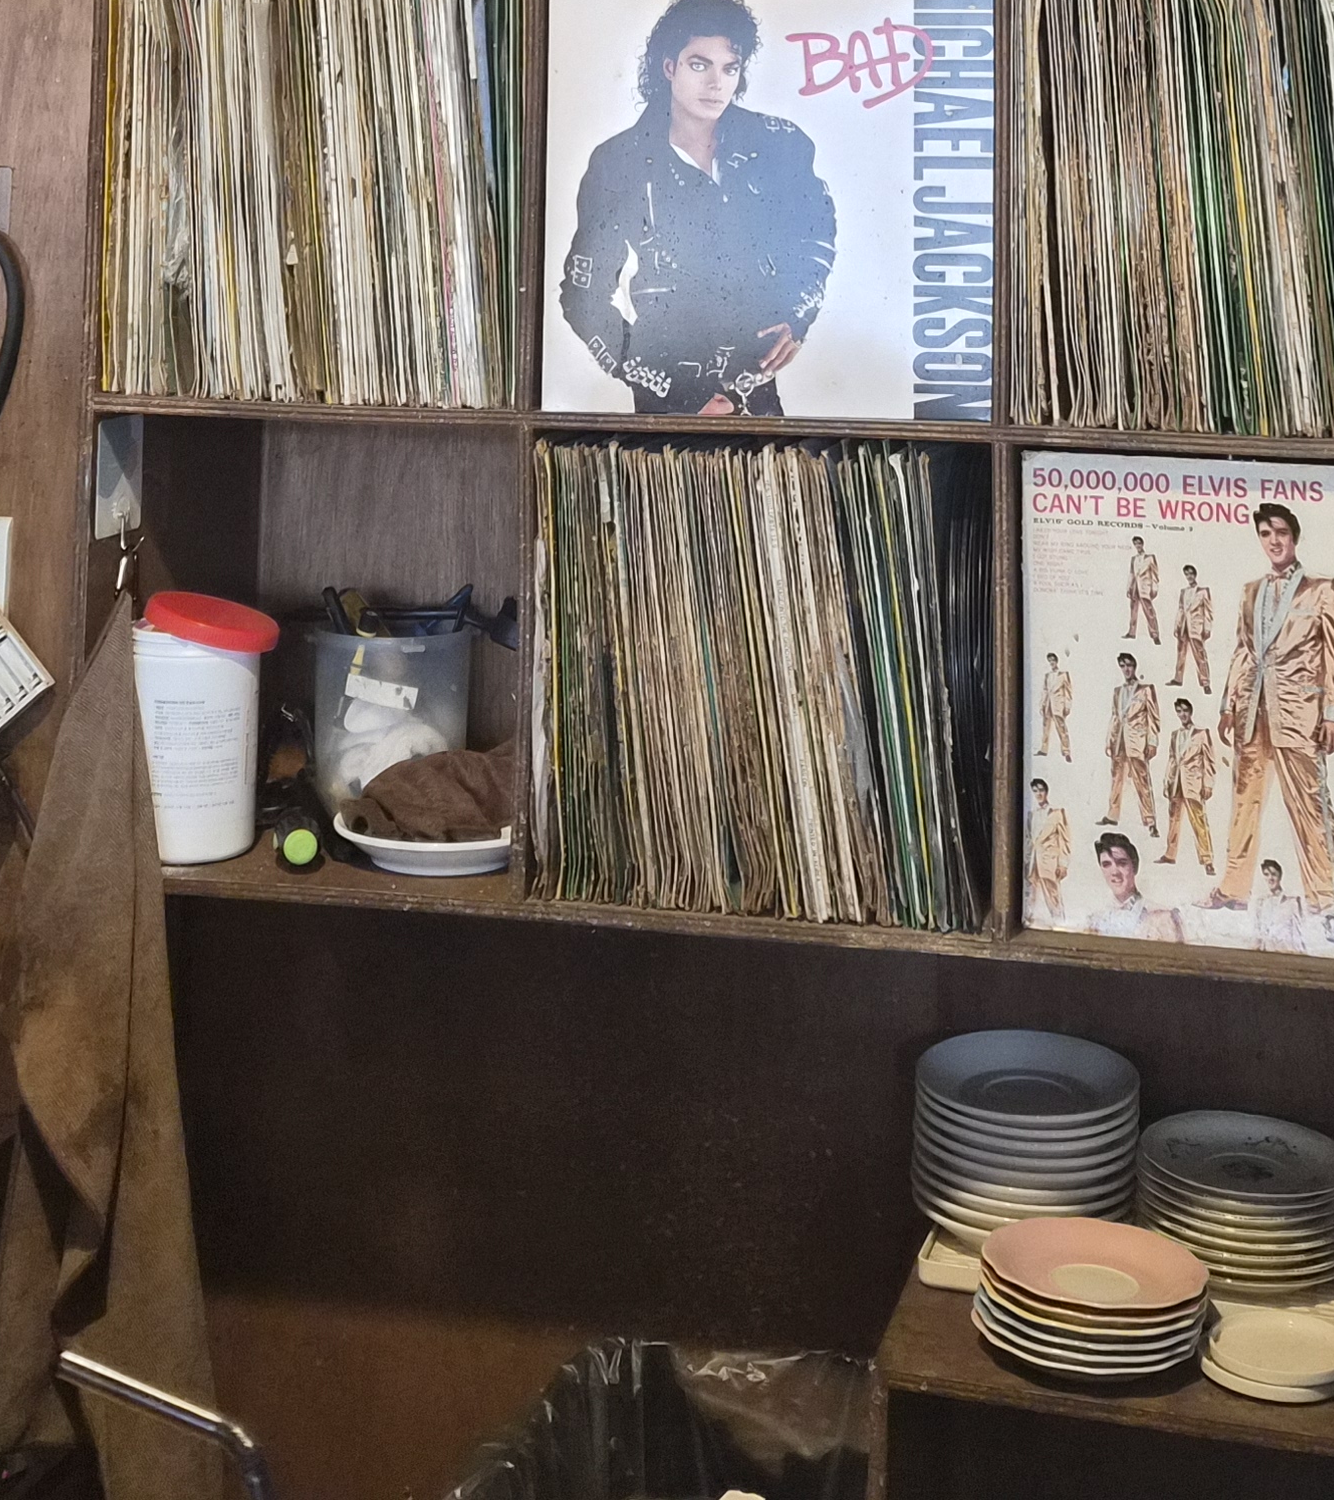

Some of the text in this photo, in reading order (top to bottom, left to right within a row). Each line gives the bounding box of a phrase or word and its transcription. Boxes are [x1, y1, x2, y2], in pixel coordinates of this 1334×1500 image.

[785, 16, 935, 109] BAD
[912, 184, 994, 422] JACKSON
[1032, 467, 1325, 502] 50,000,000 ELVIS FANS
[1032, 492, 1250, 524] CAN'T BE WRONG
[1066, 518, 1094, 526] GOLD
[1097, 520, 1144, 530] RECORDS
